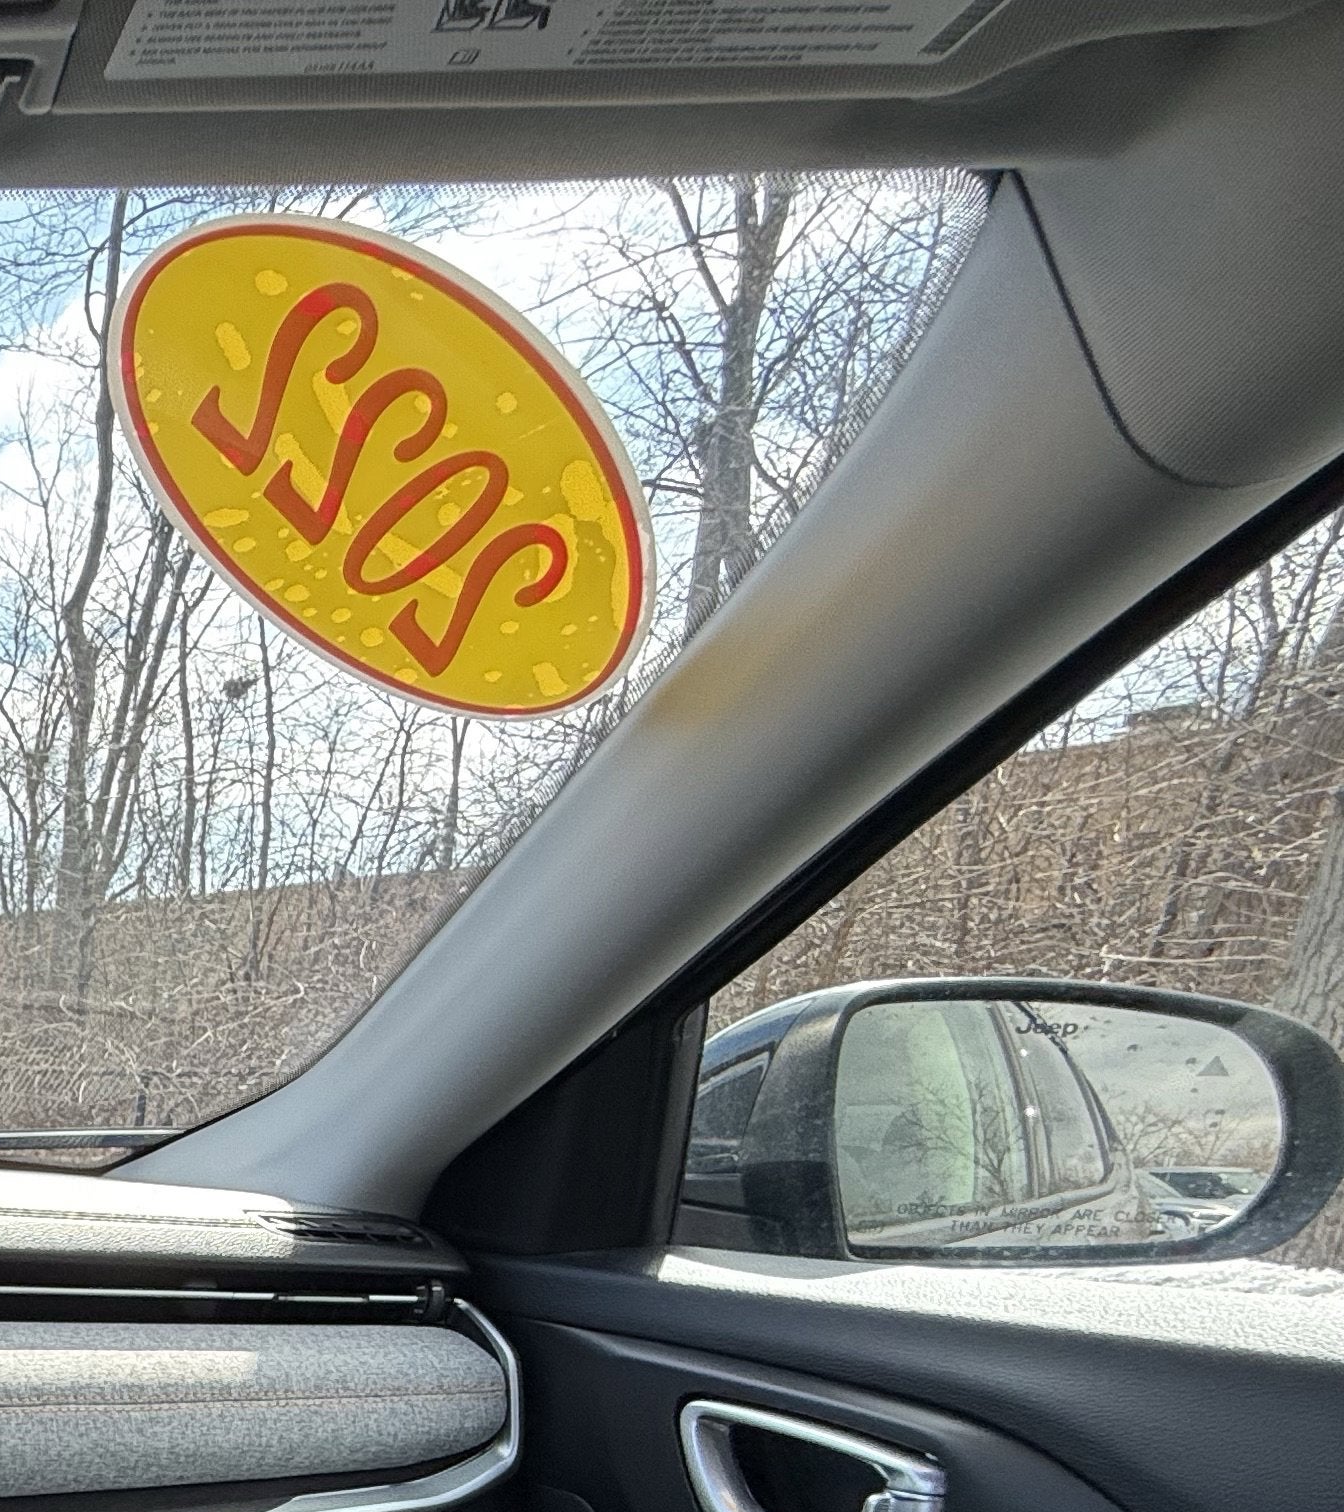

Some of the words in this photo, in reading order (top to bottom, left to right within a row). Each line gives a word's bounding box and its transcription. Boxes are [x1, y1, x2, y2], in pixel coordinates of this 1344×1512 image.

[1015, 1022, 1079, 1038] Jeep
[896, 1203, 969, 1217] OBJECTS
[975, 1206, 989, 1217] IN
[1001, 1207, 1064, 1220] MIRROR
[1071, 1209, 1101, 1221] ARE
[951, 1219, 994, 1232] THAN
[1002, 1222, 1042, 1235] THEY
[1050, 1225, 1121, 1238] APPEAR
